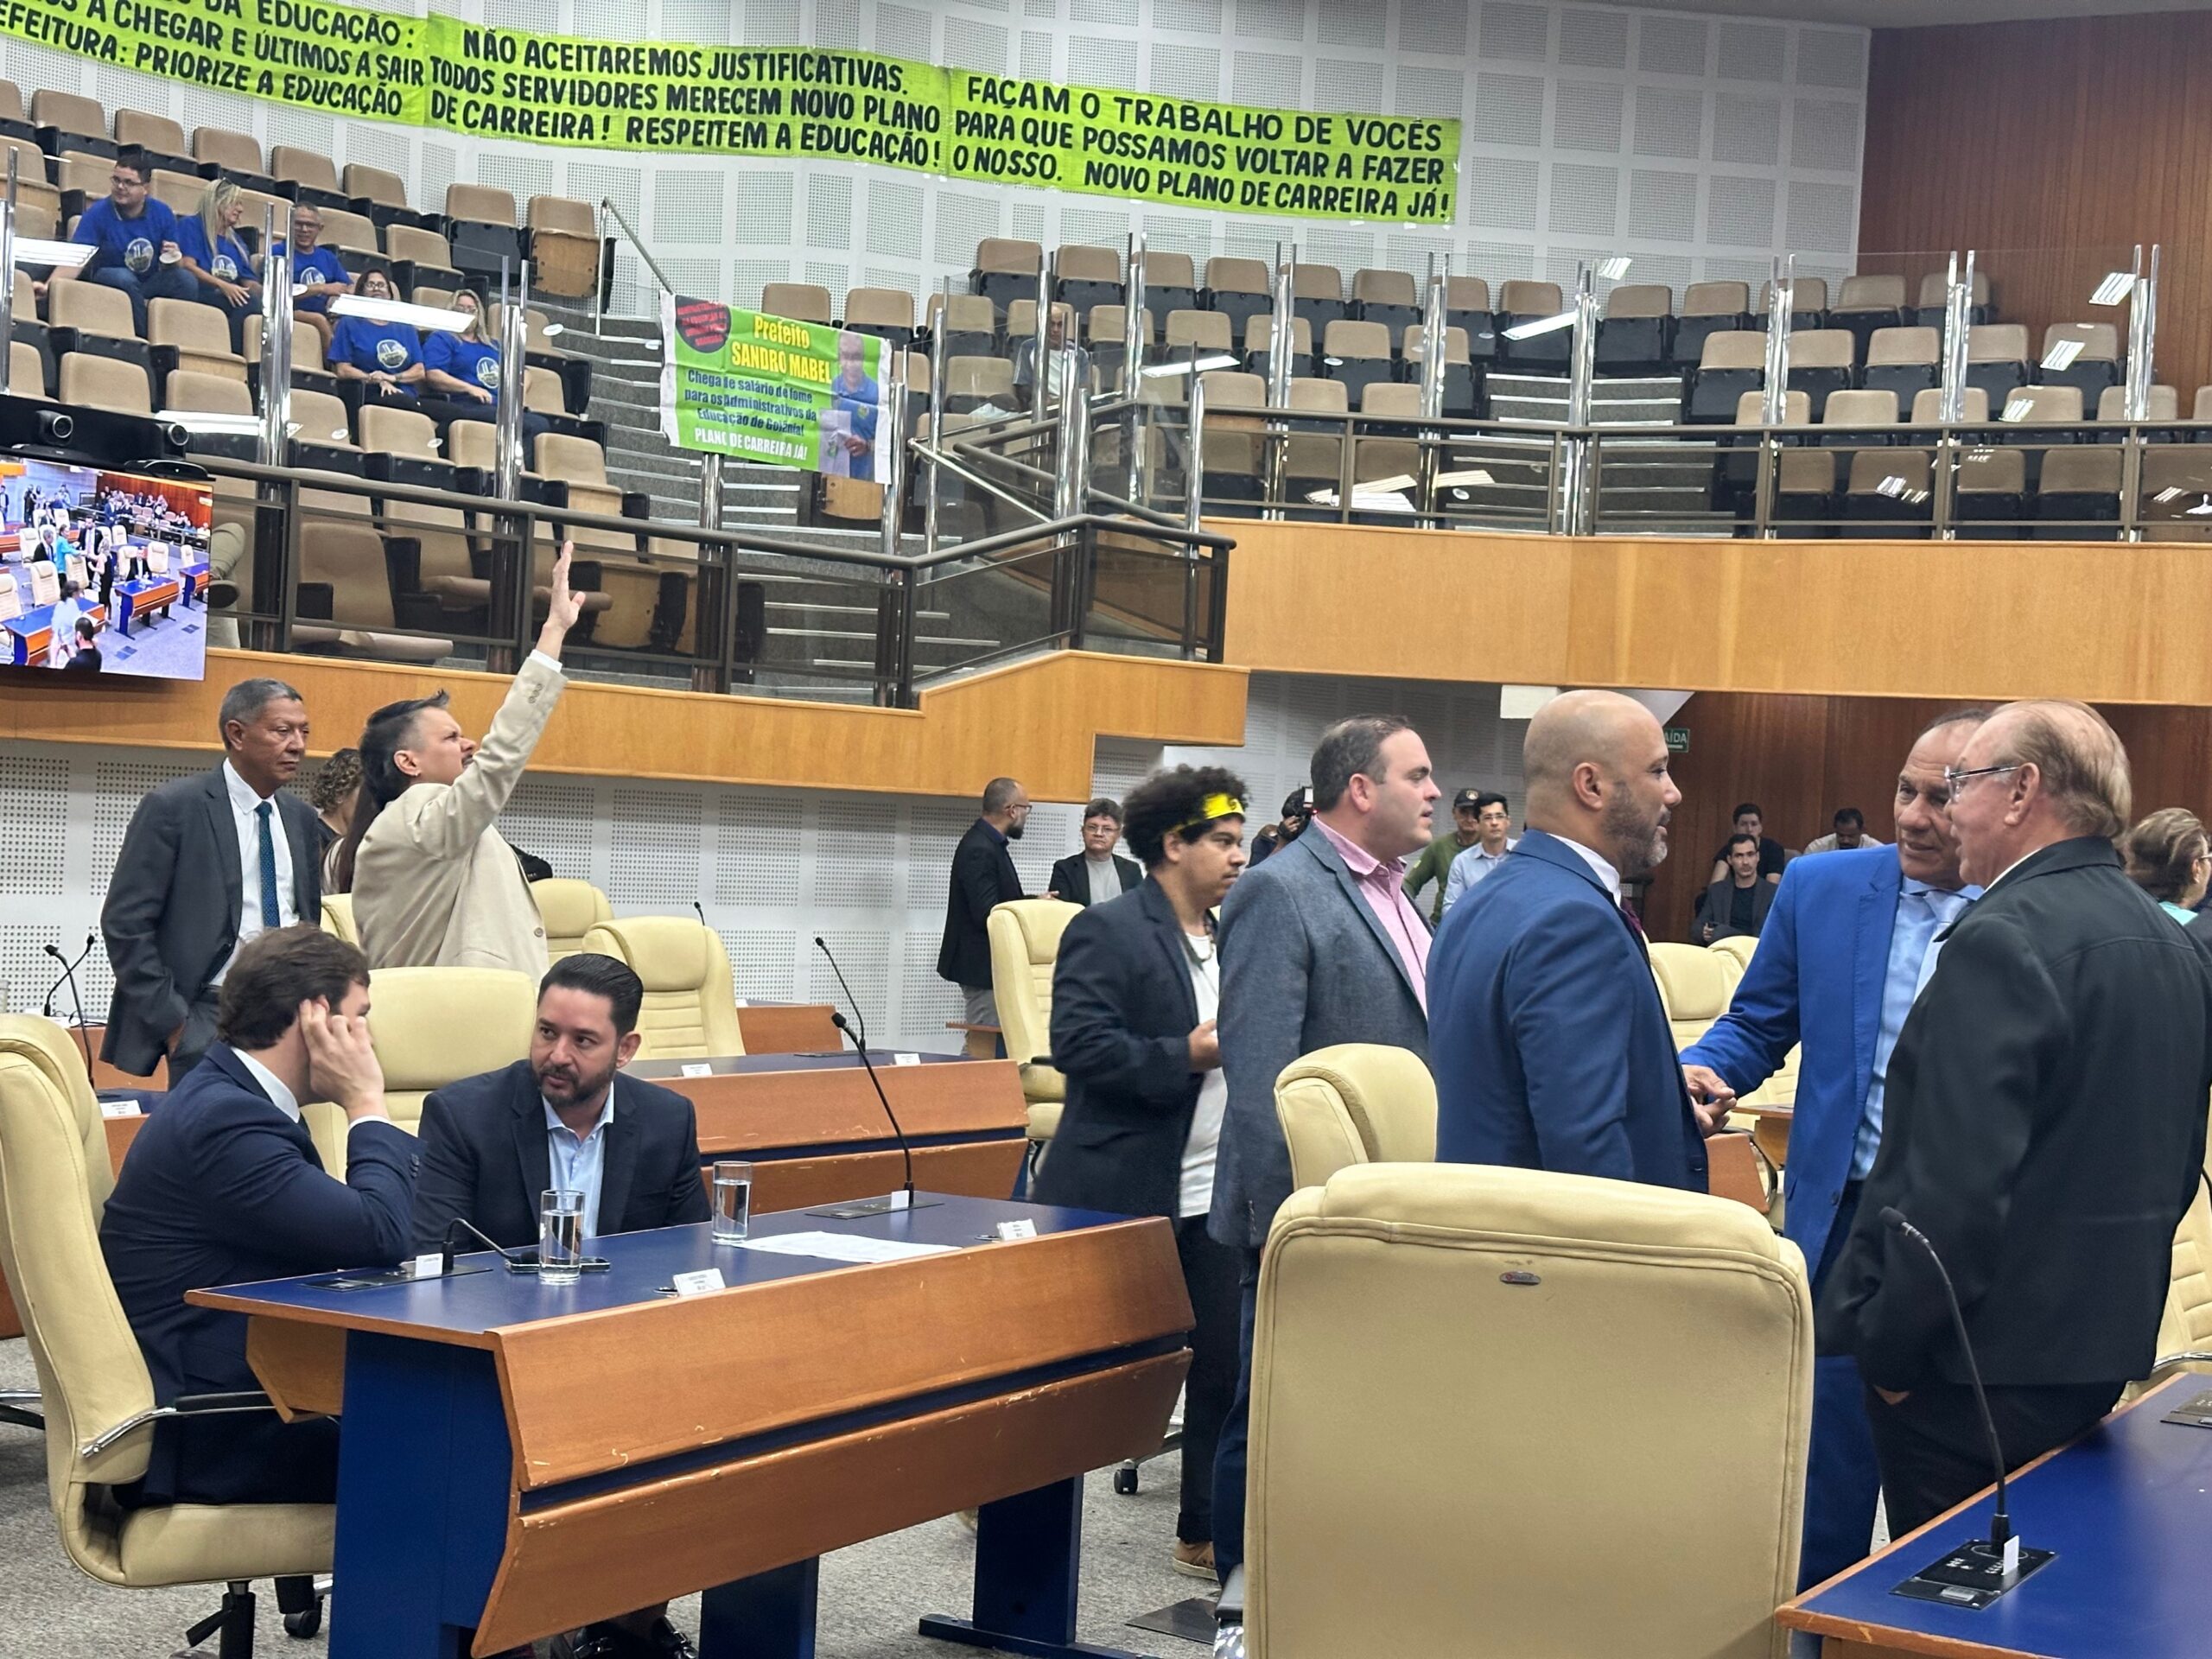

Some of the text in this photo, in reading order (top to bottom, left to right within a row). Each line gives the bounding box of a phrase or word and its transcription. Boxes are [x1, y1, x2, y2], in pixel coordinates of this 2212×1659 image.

[114, 2, 223, 51] CHEGAR
[232, 29, 246, 56] E
[255, 29, 352, 74] ÚLTIMOS
[356, 51, 370, 77] A
[377, 54, 423, 86] SAIR
[464, 29, 907, 94] NÃO ACEITAREMOS JUSTIFICATIVAS.
[136, 42, 251, 91] PRIORIZE
[257, 70, 273, 95] A
[283, 73, 402, 116] EDUCAÇÃO
[430, 56, 939, 132] TODOS SERVIDORES MERECEM NOVO PLANO
[432, 90, 457, 124] DE
[626, 117, 766, 148] RESPEITEM
[776, 123, 791, 149] A
[801, 124, 939, 167] EDUCAÇÃO!
[969, 77, 1441, 151] FAÇAM O TRABALHO DE VOCÊS
[956, 111, 1444, 184] PARA QUE POSSAMOS VOLTAR A FAZER
[954, 145, 1448, 218] O NOSSO. NOVO PLANO DE CARREIRA JÁ!
[732, 341, 832, 385] SANDRO MABEL
[754, 315, 810, 349] Prefeito
[684, 389, 709, 404] para
[710, 394, 722, 405] os
[805, 409, 817, 423] da
[688, 369, 721, 387] Chega
[738, 379, 774, 396] salário
[776, 385, 788, 398] de
[697, 407, 749, 427] Educação
[751, 415, 764, 429] de
[730, 432, 743, 448] DE
[744, 435, 792, 458] CARREIRA
[793, 442, 809, 461] JÁ!
[1664, 729, 1688, 744] AÍDA
